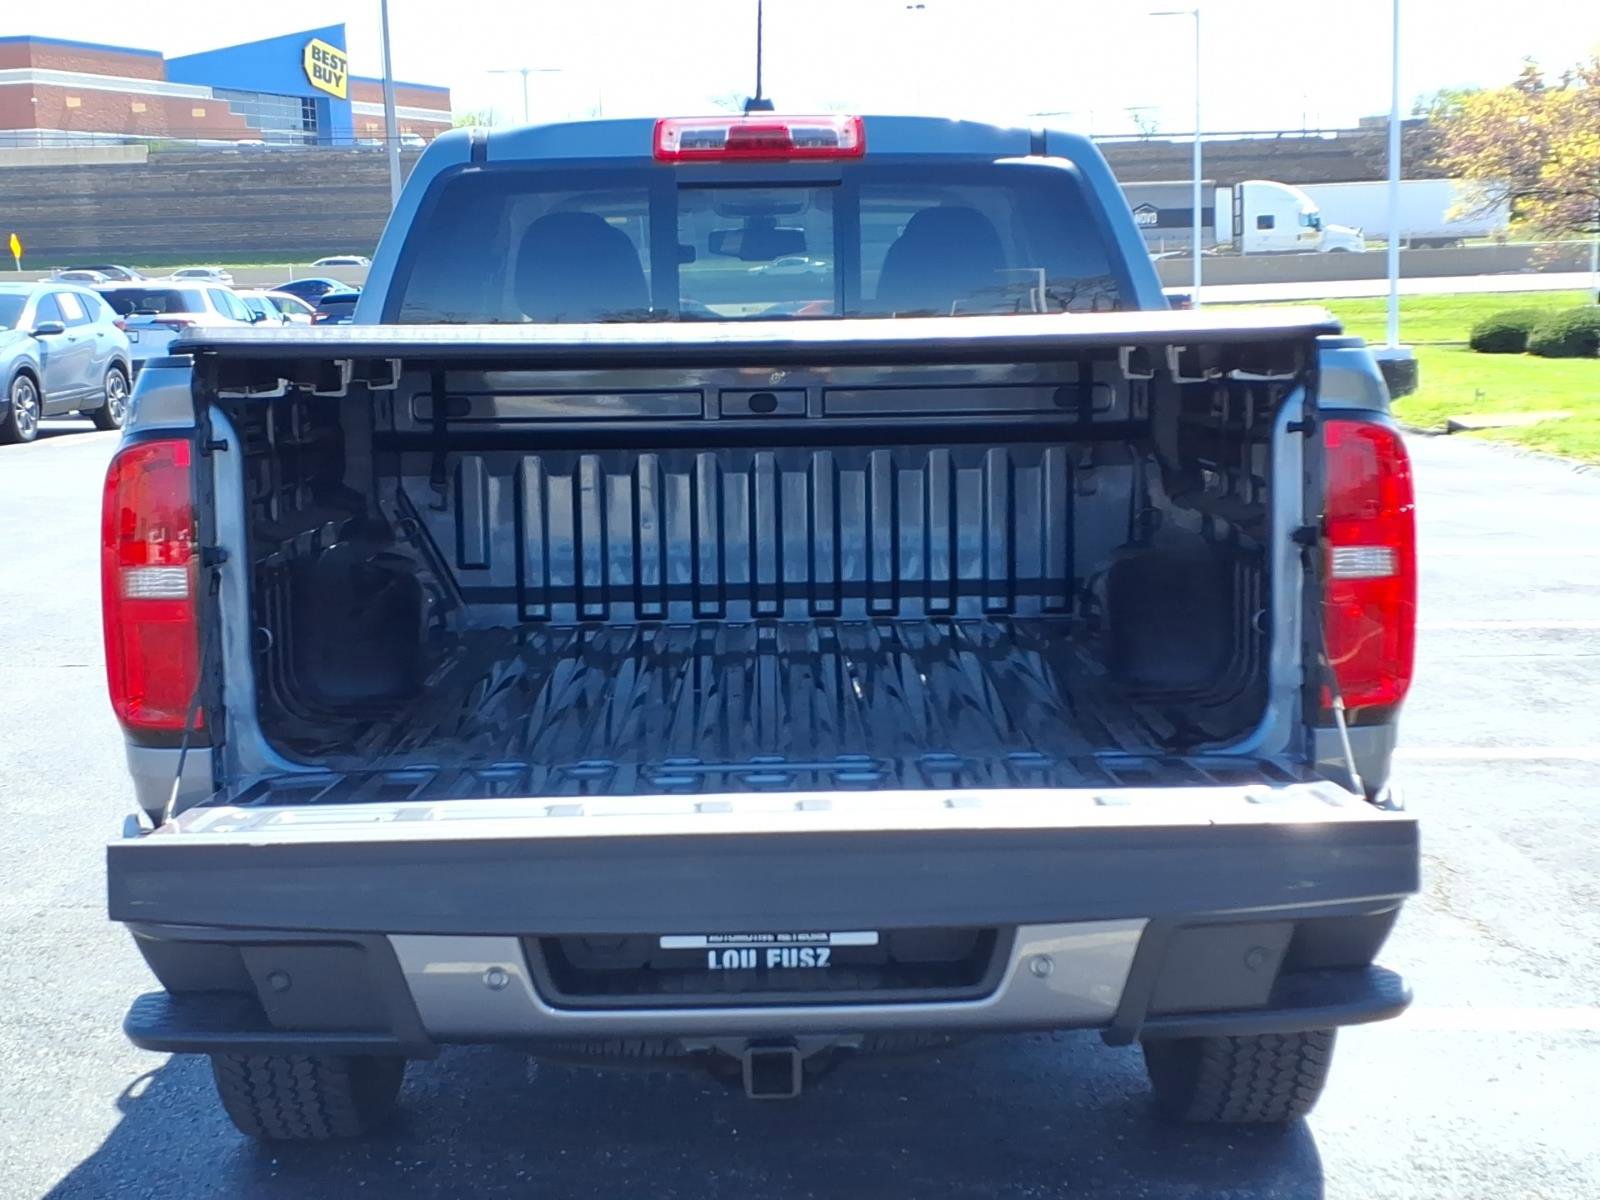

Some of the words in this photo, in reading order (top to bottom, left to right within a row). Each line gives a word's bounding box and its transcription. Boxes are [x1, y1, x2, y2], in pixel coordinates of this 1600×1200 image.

[312, 44, 347, 73] BEST
[313, 62, 343, 88] BUY
[708, 948, 757, 969] LOU
[766, 947, 831, 968] FUSZ
